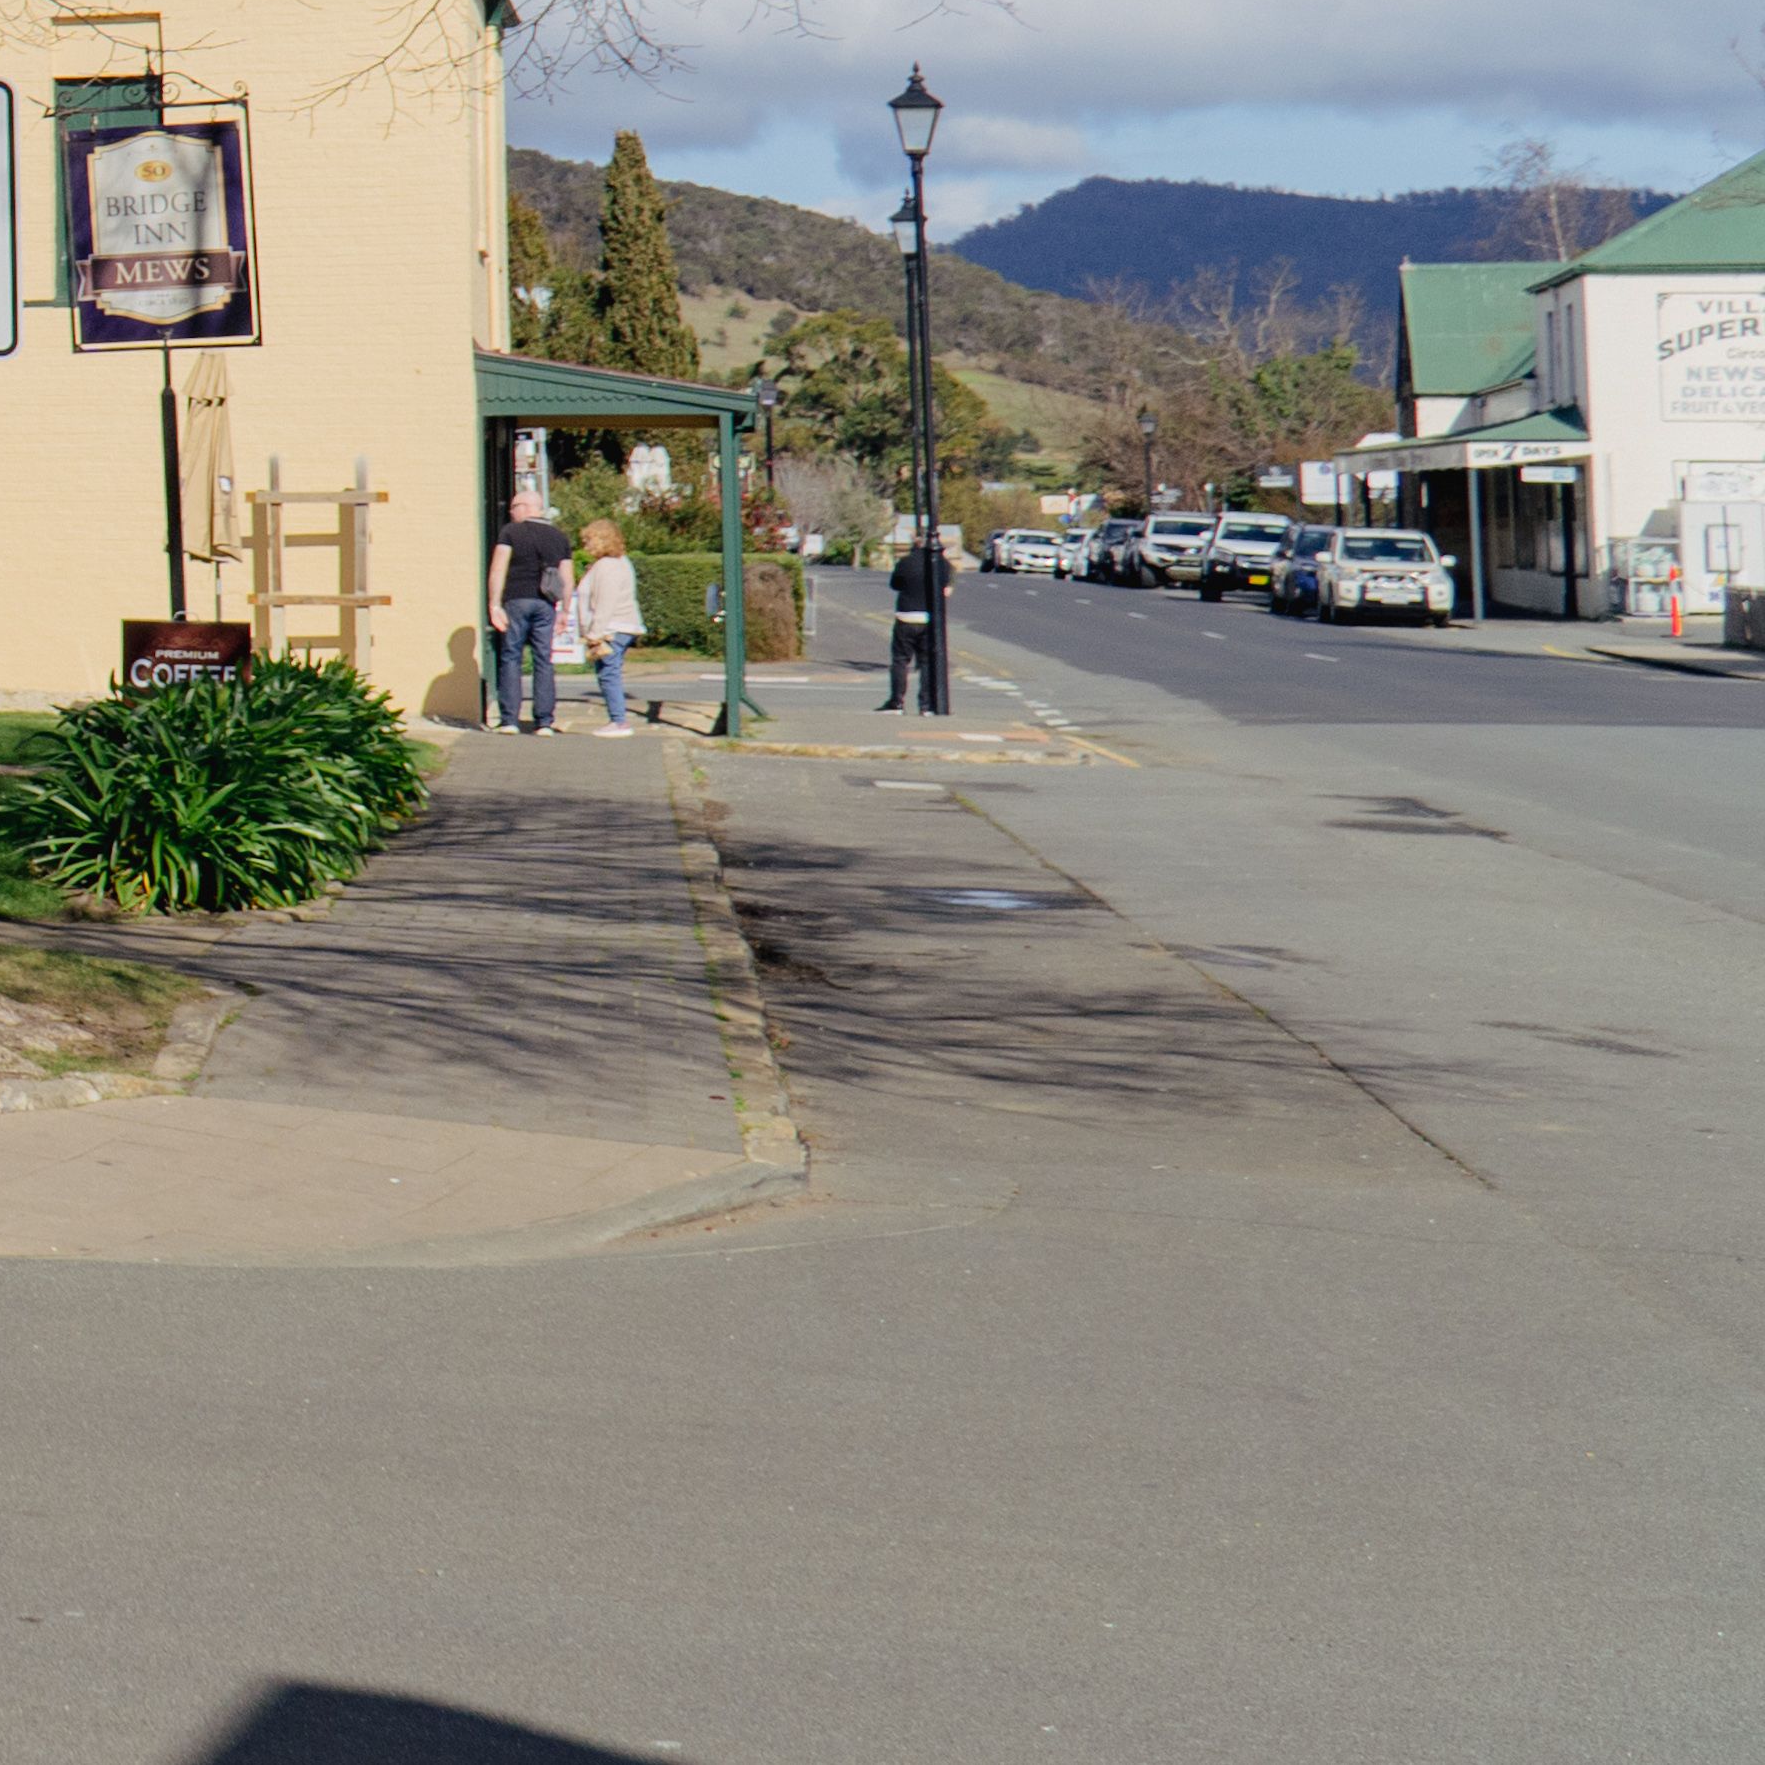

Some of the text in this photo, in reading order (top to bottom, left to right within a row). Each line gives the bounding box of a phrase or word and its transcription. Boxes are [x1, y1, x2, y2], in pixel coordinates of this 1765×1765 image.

[106, 190, 208, 218] BRIDGE
[134, 221, 189, 245] INN
[115, 257, 211, 285] MEWS
[1697, 300, 1765, 314] VILL
[1671, 401, 1719, 414] FRUIT
[155, 649, 219, 659] PREMIUM
